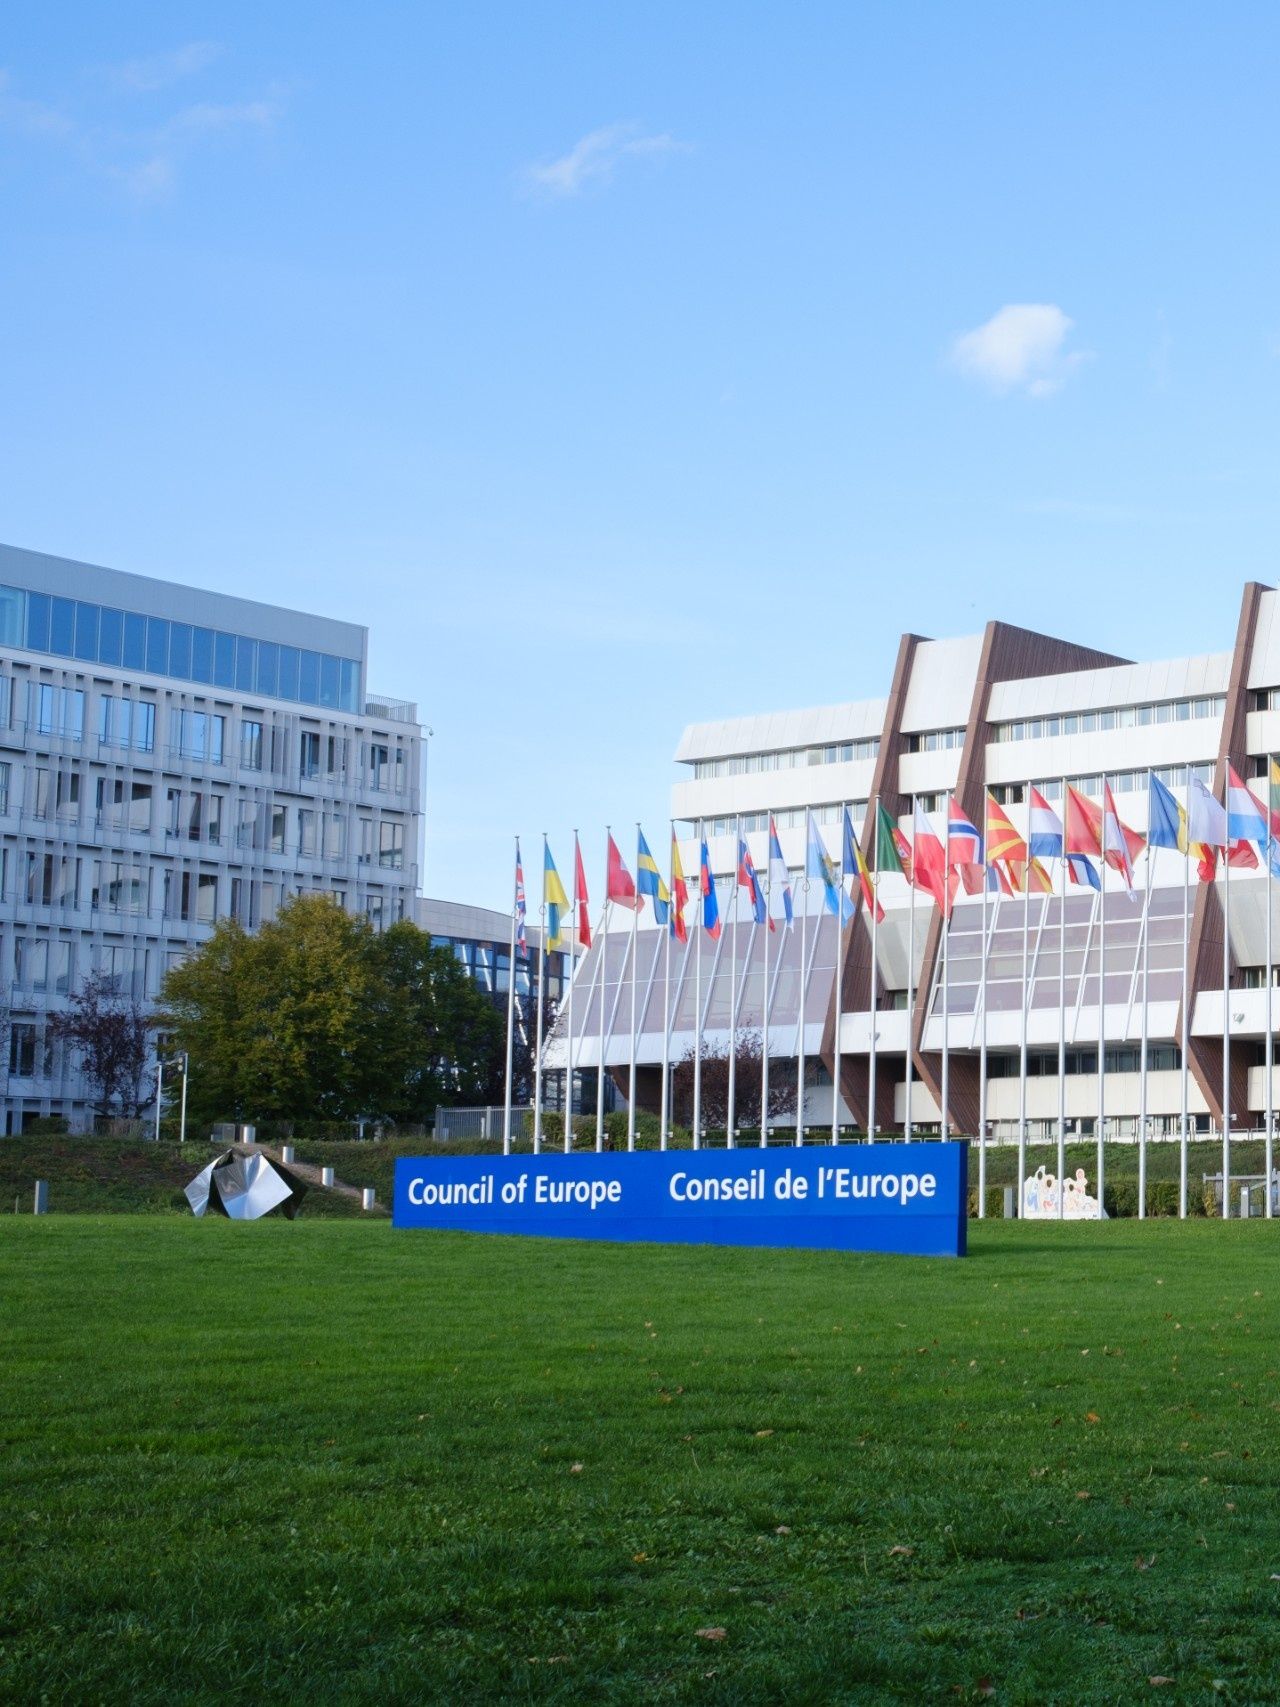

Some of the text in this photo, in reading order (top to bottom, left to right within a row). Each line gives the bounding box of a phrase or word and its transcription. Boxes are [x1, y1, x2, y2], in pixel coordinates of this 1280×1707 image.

[408, 1173, 622, 1210] Council of Europe
[669, 1166, 937, 1206] Conseil de l'Europe
